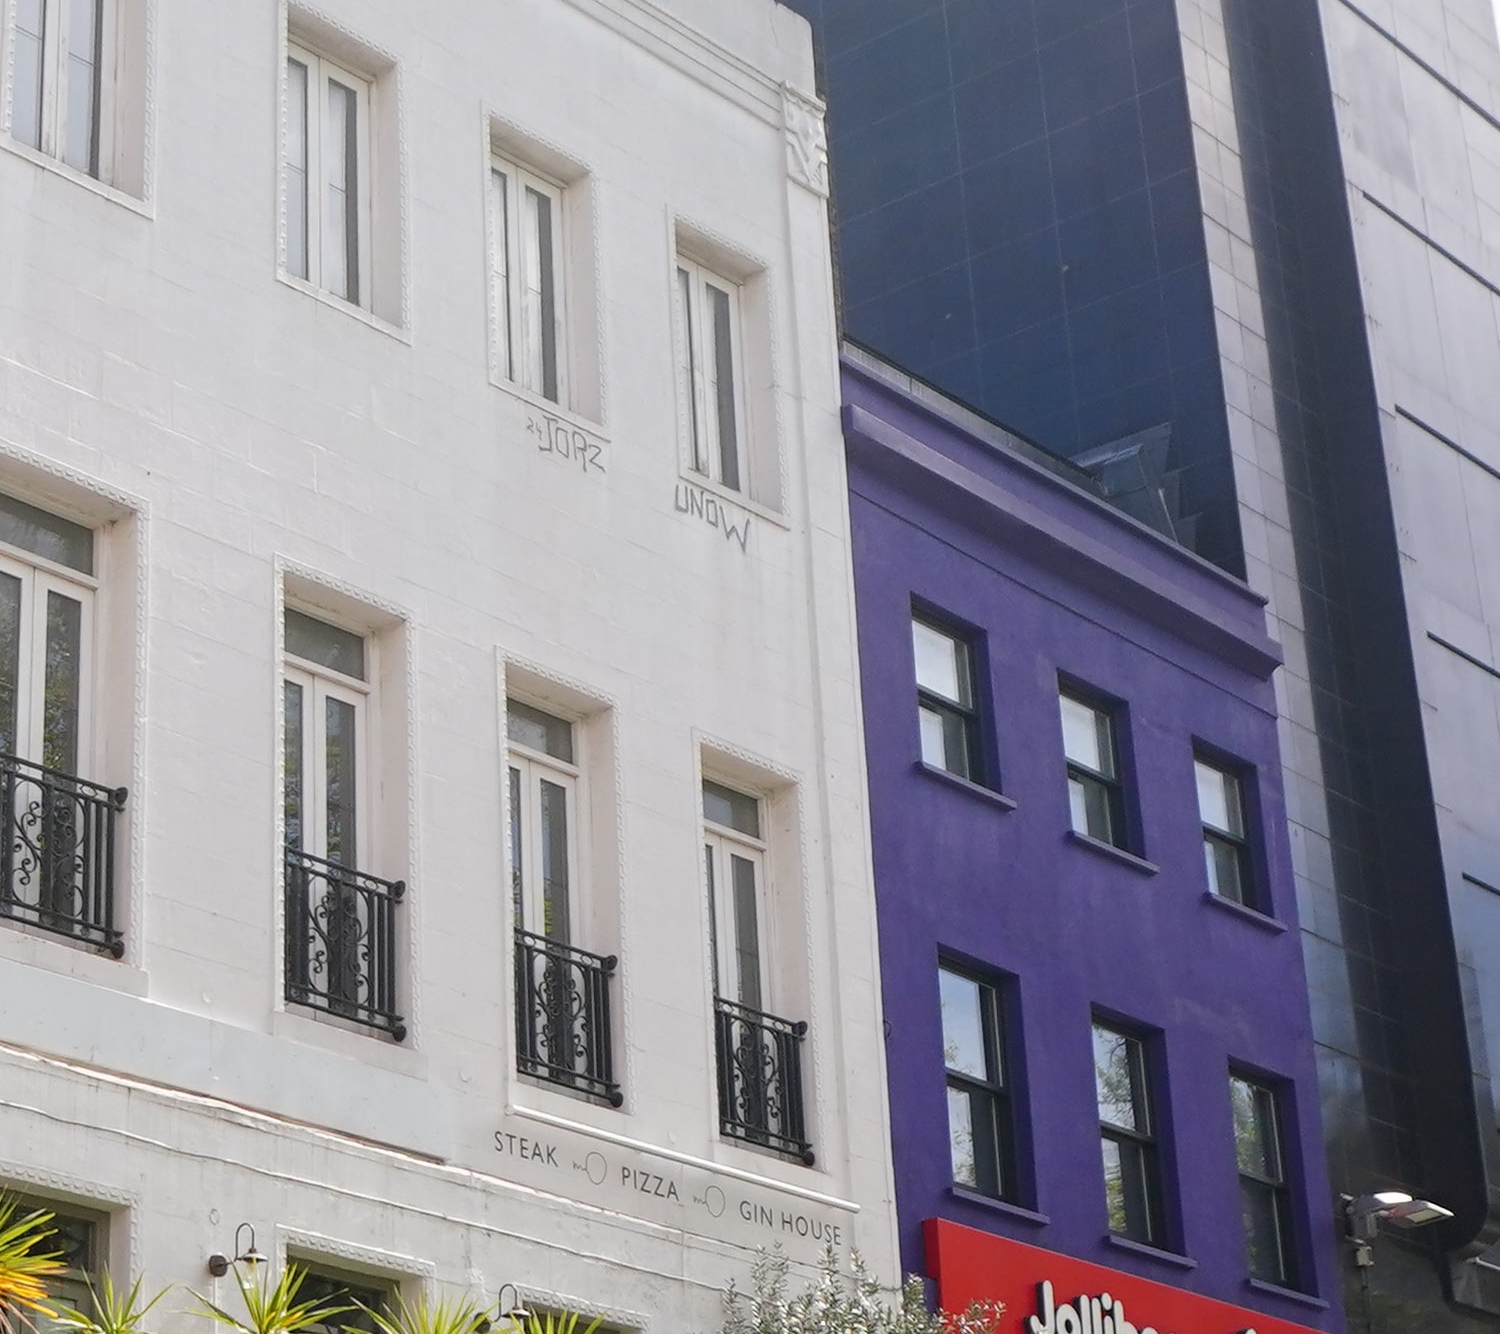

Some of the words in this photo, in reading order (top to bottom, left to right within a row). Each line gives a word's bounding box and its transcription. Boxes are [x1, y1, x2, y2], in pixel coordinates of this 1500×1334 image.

[494, 1131, 559, 1167] STEAK
[621, 1167, 680, 1203] PIZZA
[739, 1199, 773, 1228] GIN
[781, 1211, 841, 1246] HOUSE
